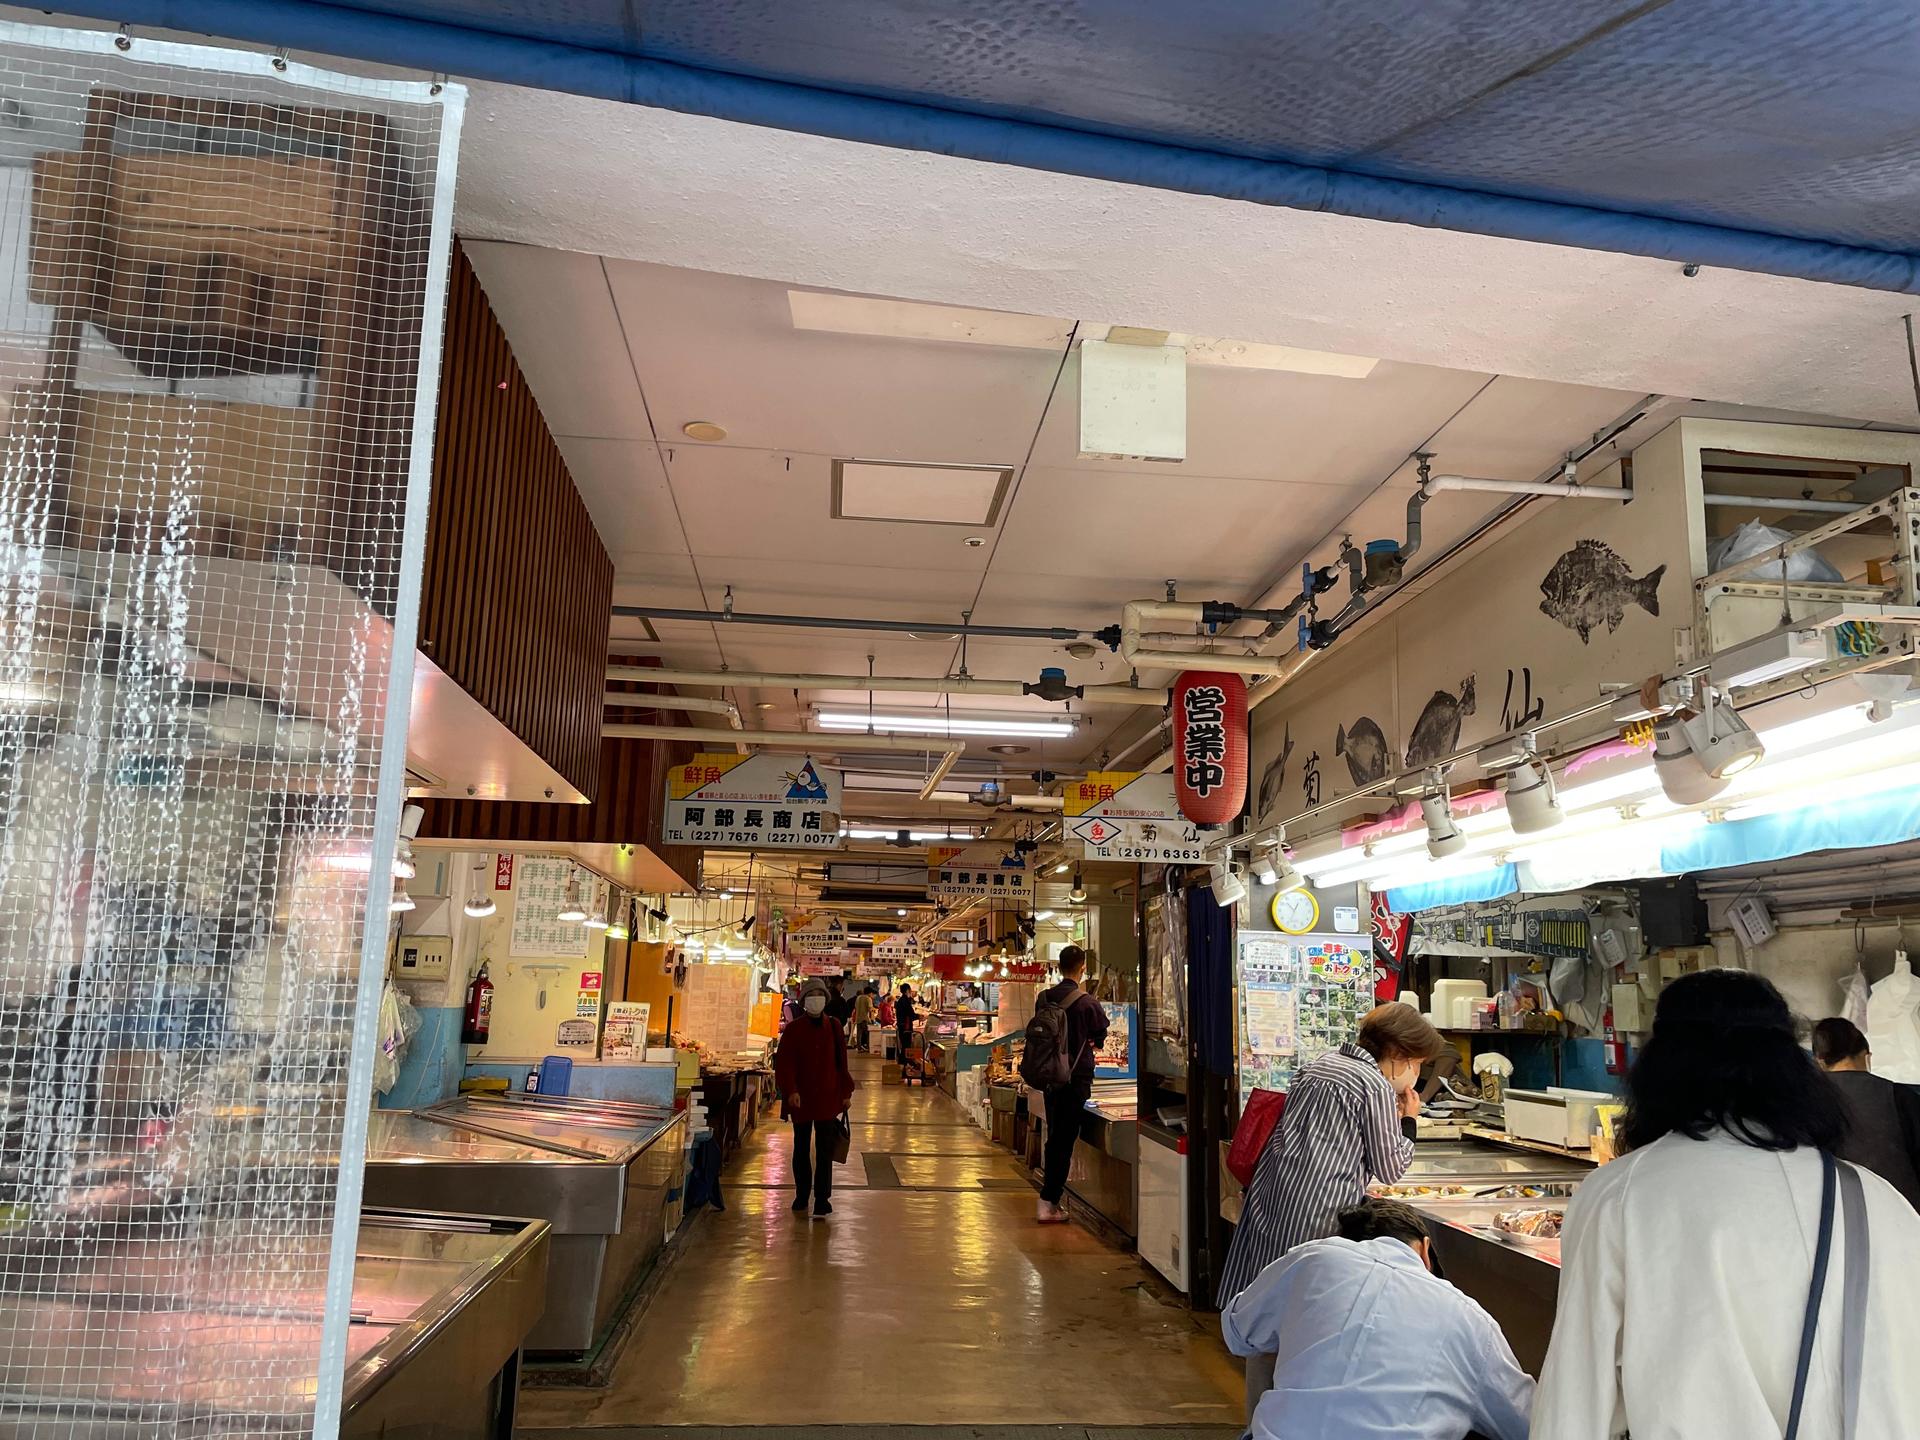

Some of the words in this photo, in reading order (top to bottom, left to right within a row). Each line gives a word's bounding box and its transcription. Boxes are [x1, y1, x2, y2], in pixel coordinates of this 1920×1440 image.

[1186, 687, 1225, 798] 営業中
[683, 766, 722, 784] 鮮魚
[1303, 750, 1322, 809] 菊
[1080, 784, 1115, 801] 鮮魚
[684, 807, 821, 830] 阿部長商店
[1108, 809, 1165, 817] お持ち帰り安心の店
[668, 830, 684, 840] TEL
[1090, 823, 1106, 840] 魚
[1097, 847, 1111, 857] TEL
[498, 853, 512, 886] 消火器
[940, 872, 1022, 886] 阿部長商店
[1324, 963, 1361, 976] おトク市
